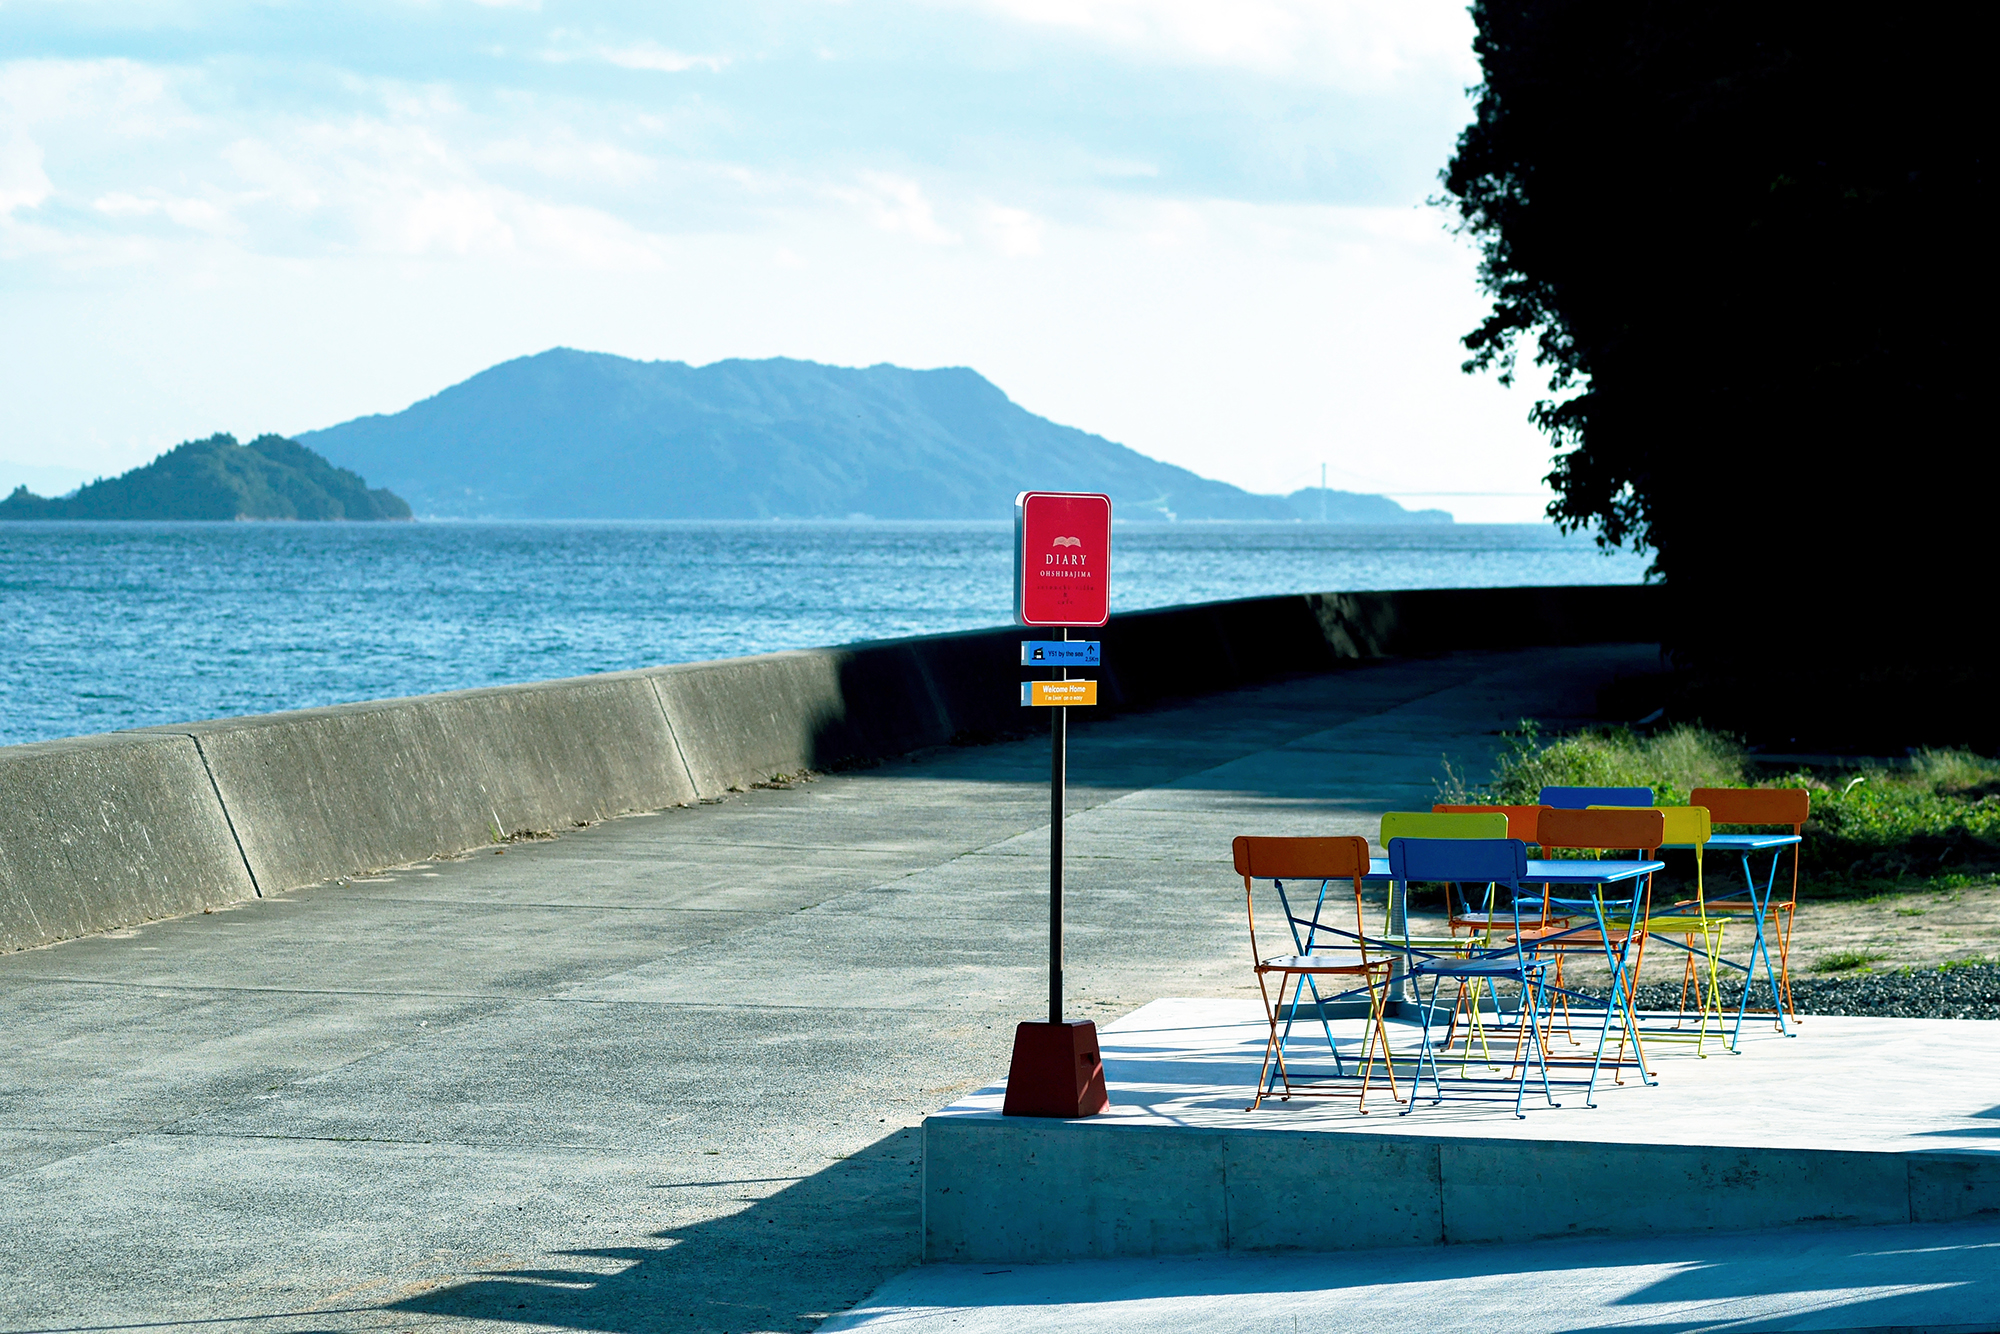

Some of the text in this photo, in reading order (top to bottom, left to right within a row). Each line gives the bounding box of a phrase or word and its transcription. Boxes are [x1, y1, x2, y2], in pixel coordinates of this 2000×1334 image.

[1045, 553, 1087, 565] DIARY
[1040, 570, 1091, 578] OHSHIBAJIMA
[1058, 650, 1065, 658] by
[1043, 685, 1086, 693] Welcome Home
